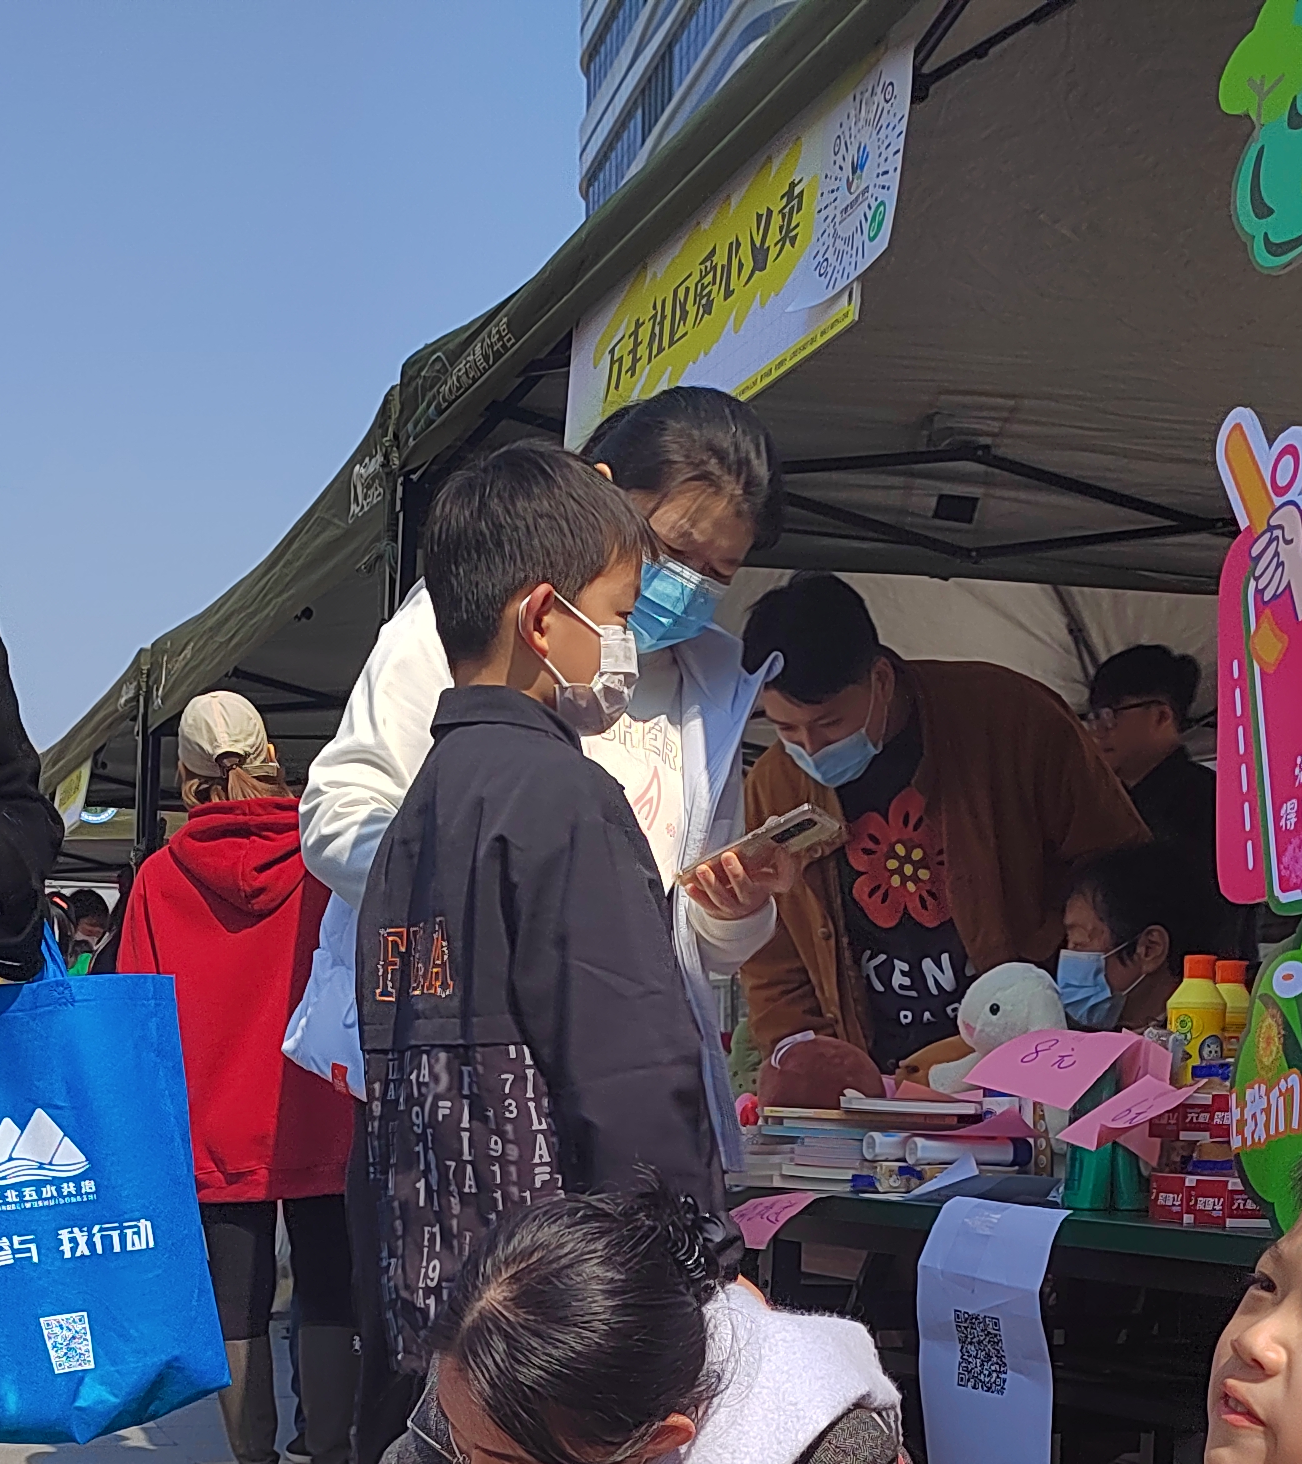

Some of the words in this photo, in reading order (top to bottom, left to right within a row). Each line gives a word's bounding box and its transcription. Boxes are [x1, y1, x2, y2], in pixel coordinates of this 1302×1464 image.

[603, 177, 805, 404] 万丰社区爱心义卖
[860, 950, 977, 998] KEN
[57, 1218, 156, 1261] 我行动
